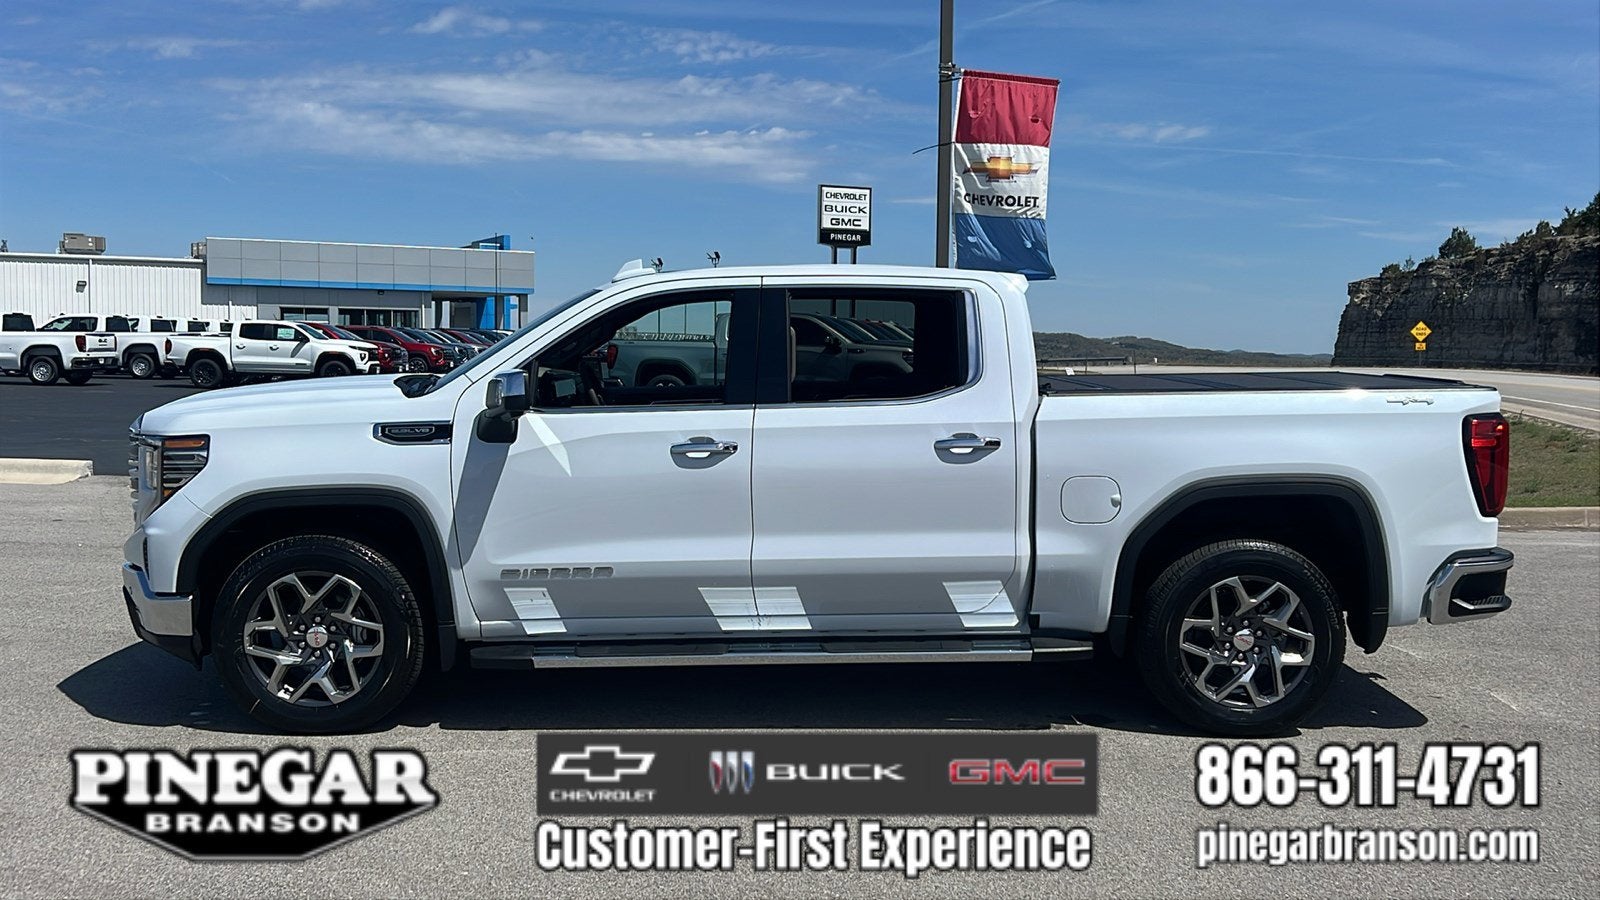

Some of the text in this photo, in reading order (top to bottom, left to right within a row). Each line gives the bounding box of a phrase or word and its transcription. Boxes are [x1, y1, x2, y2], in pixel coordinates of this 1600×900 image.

[825, 191, 868, 201] CHEVROLET
[824, 204, 868, 214] BUICK
[830, 217, 862, 227] GMC
[830, 233, 862, 242] PINEGAR
[500, 566, 614, 580] SIERRA
